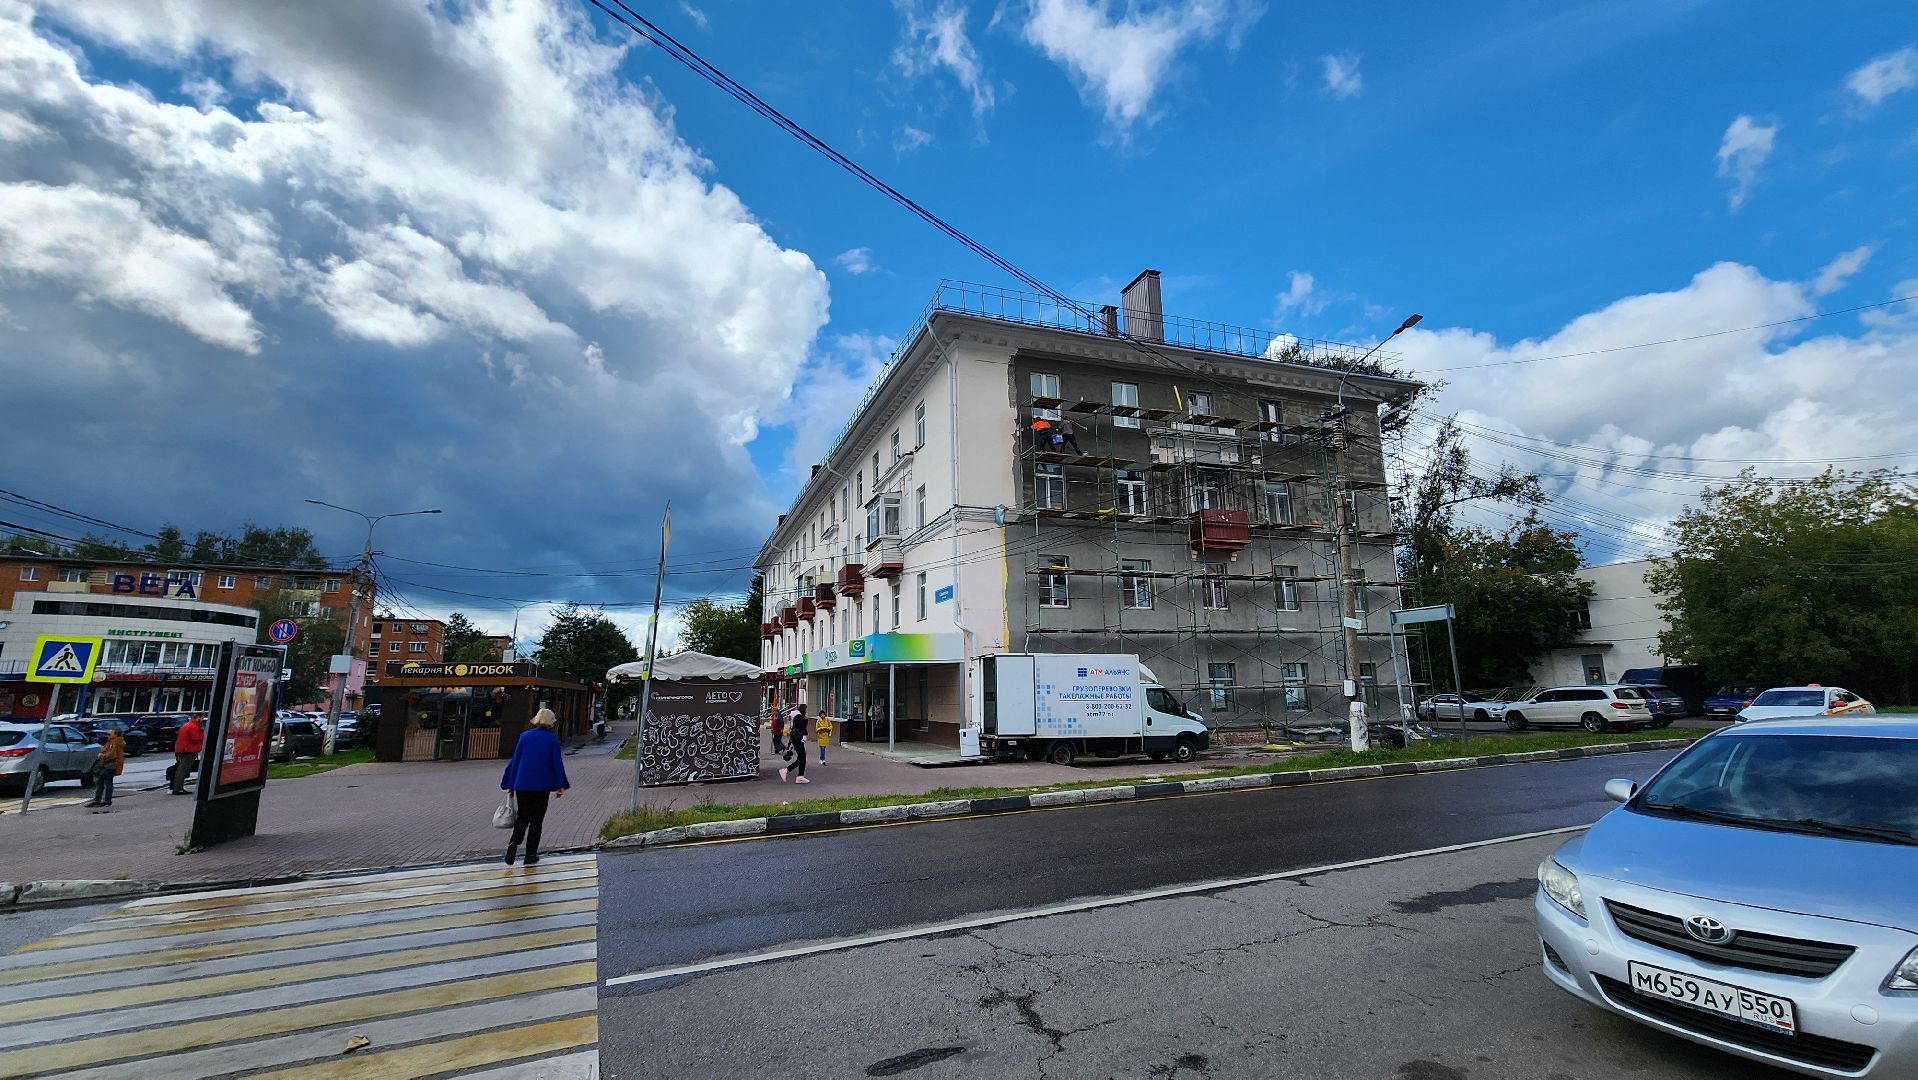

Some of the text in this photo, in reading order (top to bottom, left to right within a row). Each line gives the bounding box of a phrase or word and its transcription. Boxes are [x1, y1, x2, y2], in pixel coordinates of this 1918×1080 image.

[112, 574, 197, 599] ВЕГА
[107, 628, 183, 638] ИНСТРУМЕНТ
[1637, 971, 1785, 1019] М659АУ 550
[1752, 1012, 1776, 1024] RUS
